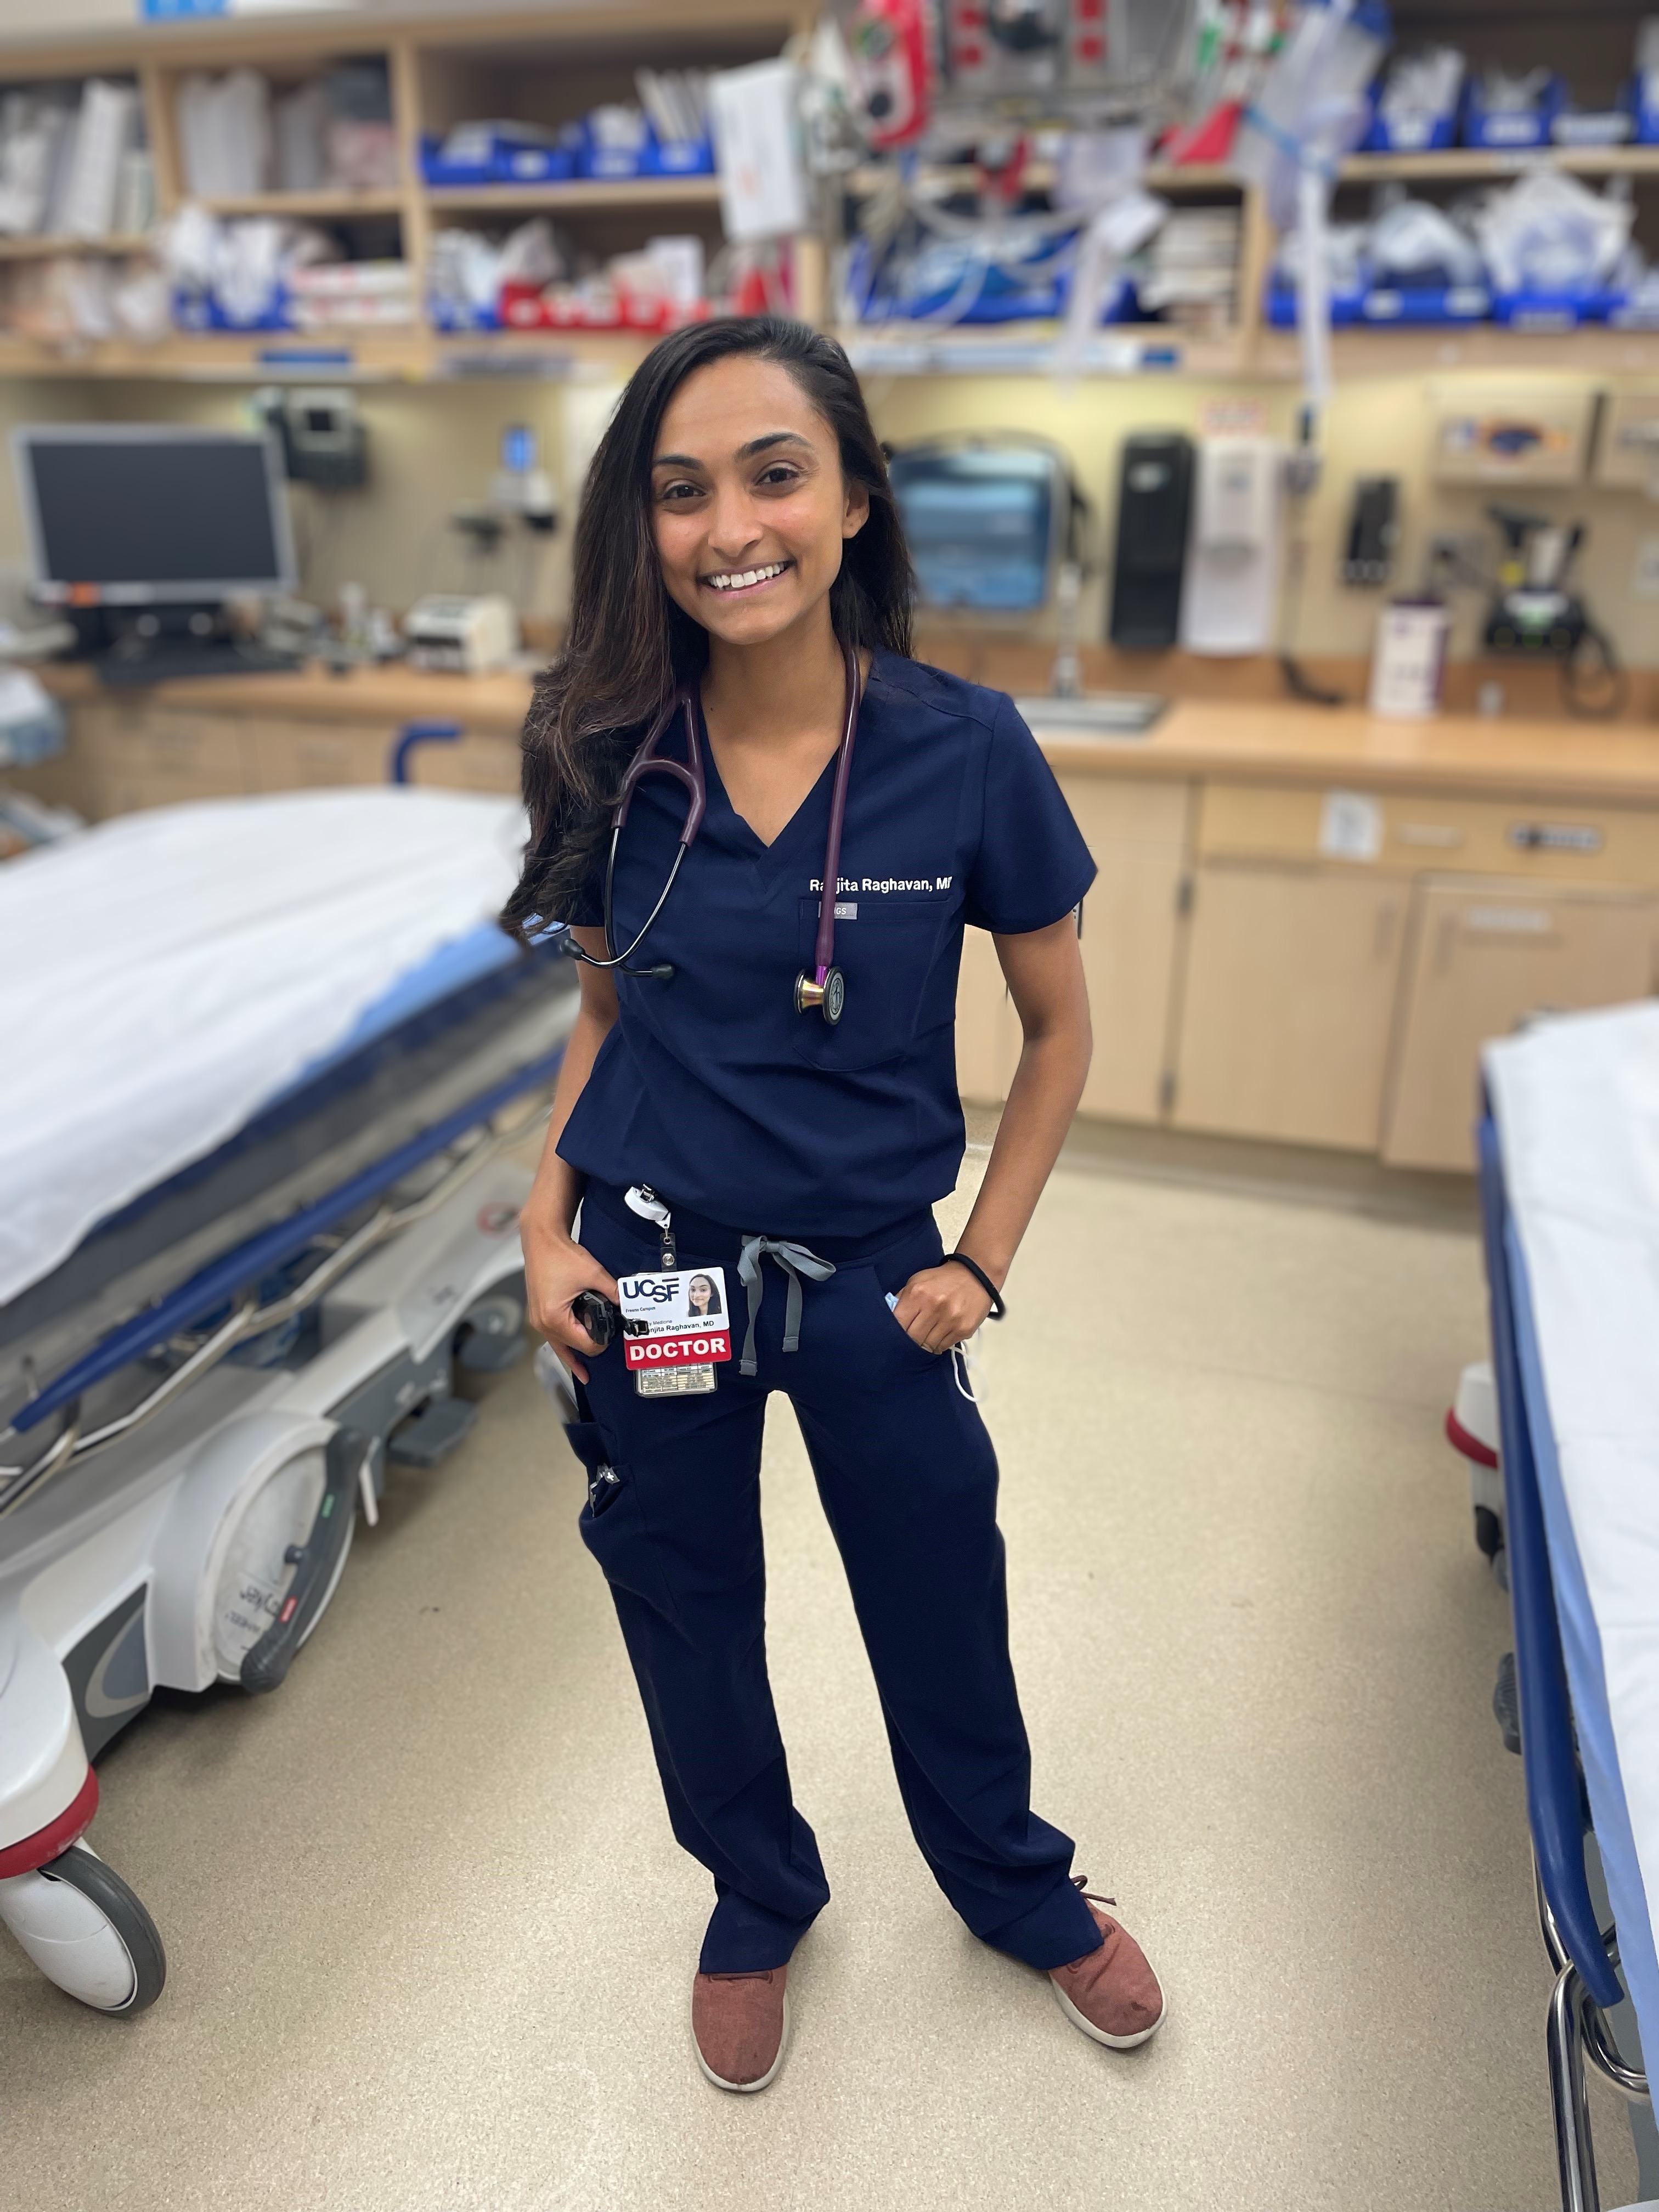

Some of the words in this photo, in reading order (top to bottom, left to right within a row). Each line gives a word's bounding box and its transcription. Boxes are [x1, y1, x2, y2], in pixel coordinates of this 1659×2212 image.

[862, 878, 933, 894] Raghavan,
[623, 1279, 680, 1303] UCSF
[666, 1323, 701, 1331] Raghavan,
[629, 1338, 726, 1361] DOCTOR
